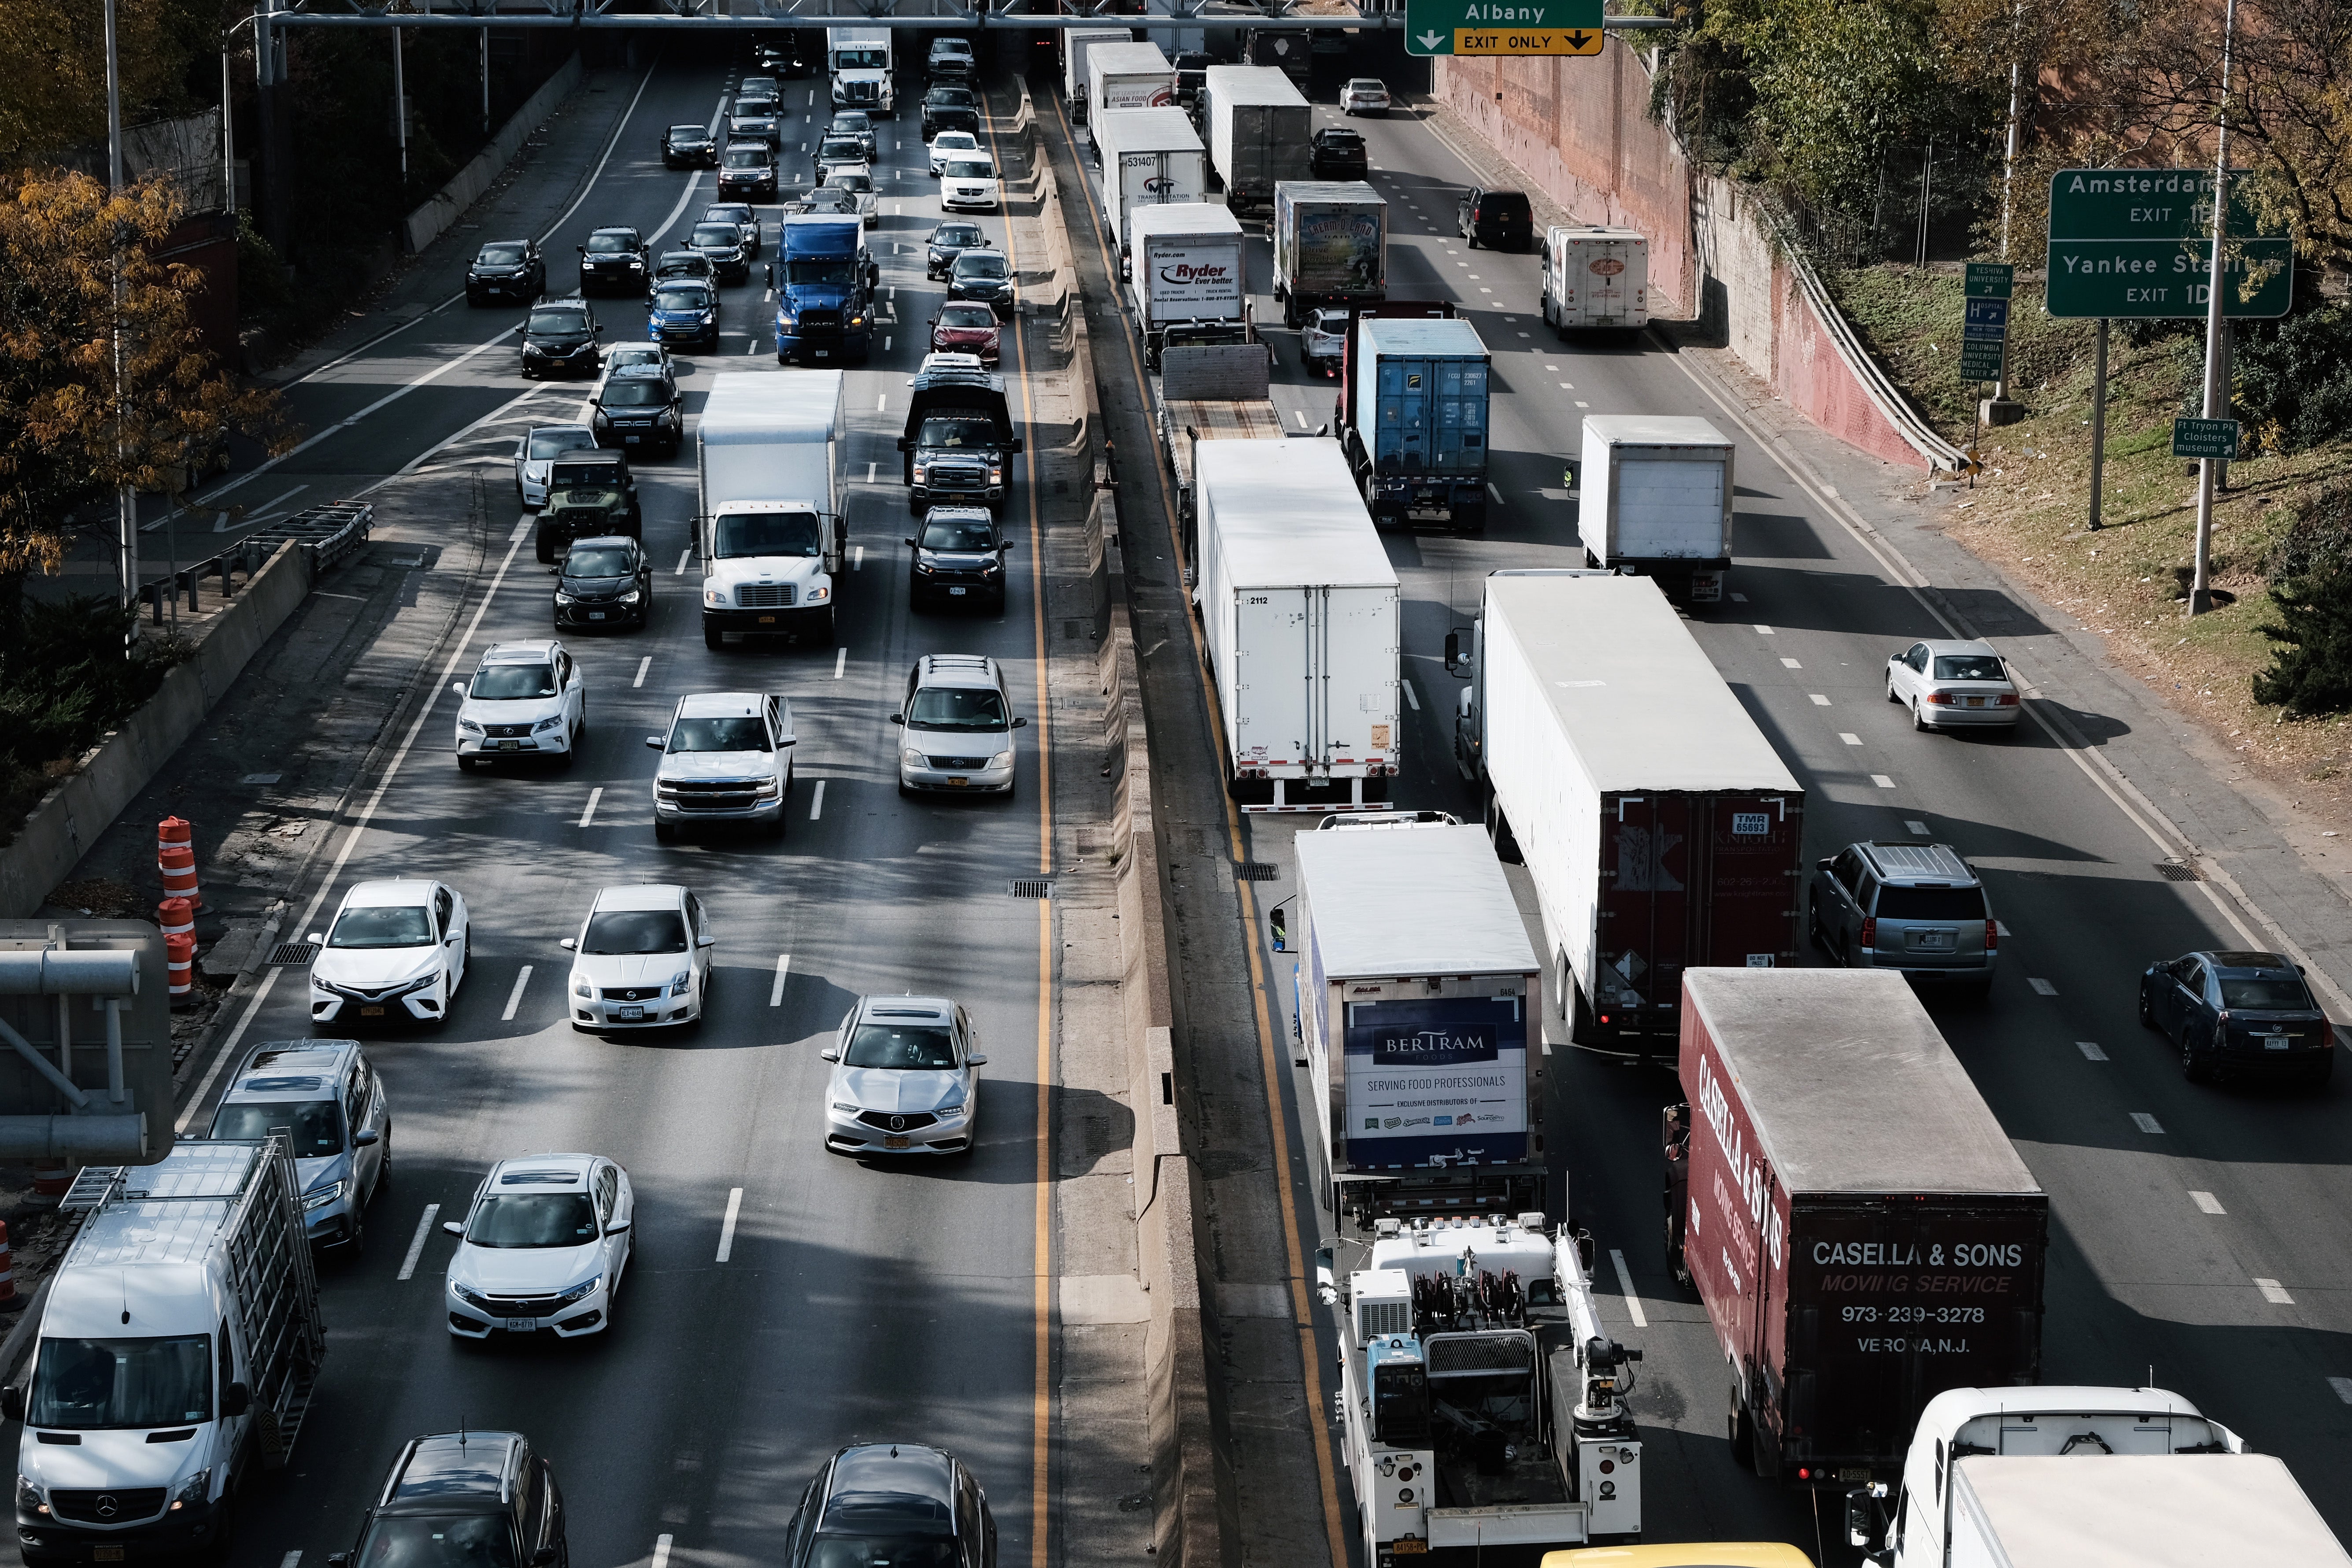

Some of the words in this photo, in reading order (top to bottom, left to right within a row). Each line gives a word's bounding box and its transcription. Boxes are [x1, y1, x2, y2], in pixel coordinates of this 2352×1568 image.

[1465, 4, 1545, 23] Albany
[1464, 36, 1498, 48] EXIT
[1509, 36, 1551, 48] ONLY
[1128, 157, 1156, 166] 531407
[2131, 208, 2172, 222] EXIT
[1176, 264, 1226, 280] Ryder
[2063, 255, 2157, 274] Yankee
[2127, 288, 2168, 301] EXIT
[2186, 284, 2210, 304] 1D
[1970, 302, 2004, 317] HOSPITAL
[1966, 343, 2000, 351] COLUMBIA
[1963, 352, 2001, 360] UNIVERSITY
[1962, 360, 1990, 369] MEDICAL
[1962, 368, 1987, 377] CENTER
[2191, 422, 2218, 432] Tryon
[2223, 423, 2234, 431] Pk
[2184, 432, 2227, 442] Cloisters
[2176, 444, 2218, 453] museum
[1737, 823, 1764, 832] 65693
[1387, 1029, 1485, 1052] BERTRAM
[1368, 1080, 1406, 1091] SERVING
[1408, 1079, 1431, 1090] FOOD
[1434, 1076, 1505, 1089] PROFESSIONALS
[1699, 1054, 1742, 1187] CASELLA
[1713, 1169, 1733, 1229] MOVING
[1732, 1211, 1756, 1278] SERVICE
[1813, 1242, 1921, 1265] CASELLA
[1929, 1243, 1945, 1266] &
[1953, 1243, 2022, 1267] SONS
[1821, 1275, 1909, 1292] MOVING
[1915, 1276, 2011, 1293] SERVICE
[1842, 1306, 1985, 1323] 973-239-3278
